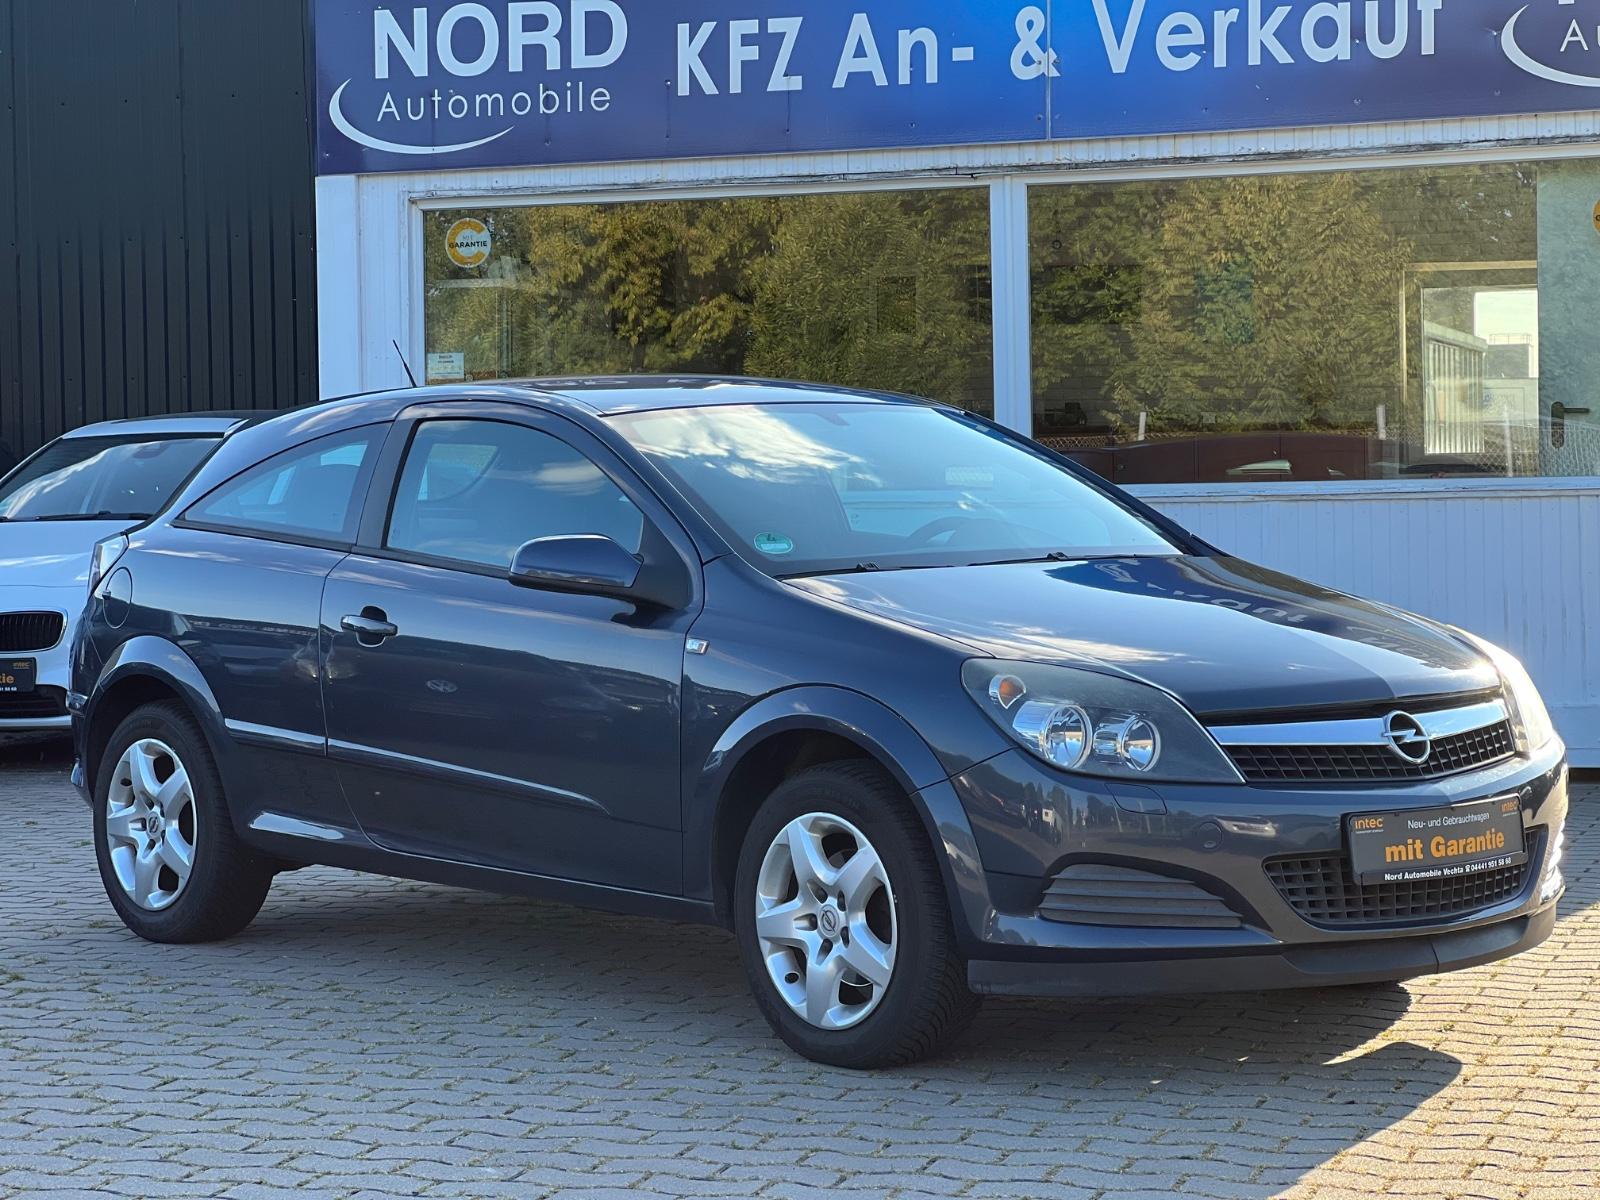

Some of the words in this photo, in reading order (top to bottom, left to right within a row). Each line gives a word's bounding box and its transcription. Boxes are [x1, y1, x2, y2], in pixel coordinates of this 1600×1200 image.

[373, 0, 628, 79] NORD
[677, 16, 803, 97] KFZ
[832, 12, 974, 89] An-
[1010, 6, 1061, 81] &
[1091, 0, 1443, 74] Verkauf
[1559, 18, 1600, 53] A
[377, 81, 611, 122] Automobile
[449, 241, 488, 249] GARANTIE
[1355, 817, 1384, 829] intec
[1407, 820, 1426, 829] Neu-
[1427, 818, 1441, 827] und
[1442, 812, 1490, 826] Gebrauchtwagen
[1385, 838, 1424, 862] mit
[1430, 828, 1505, 858] Garantie
[1384, 872, 1403, 881] Nord
[1404, 869, 1442, 879] Automobile
[1442, 866, 1464, 876] Vechta
